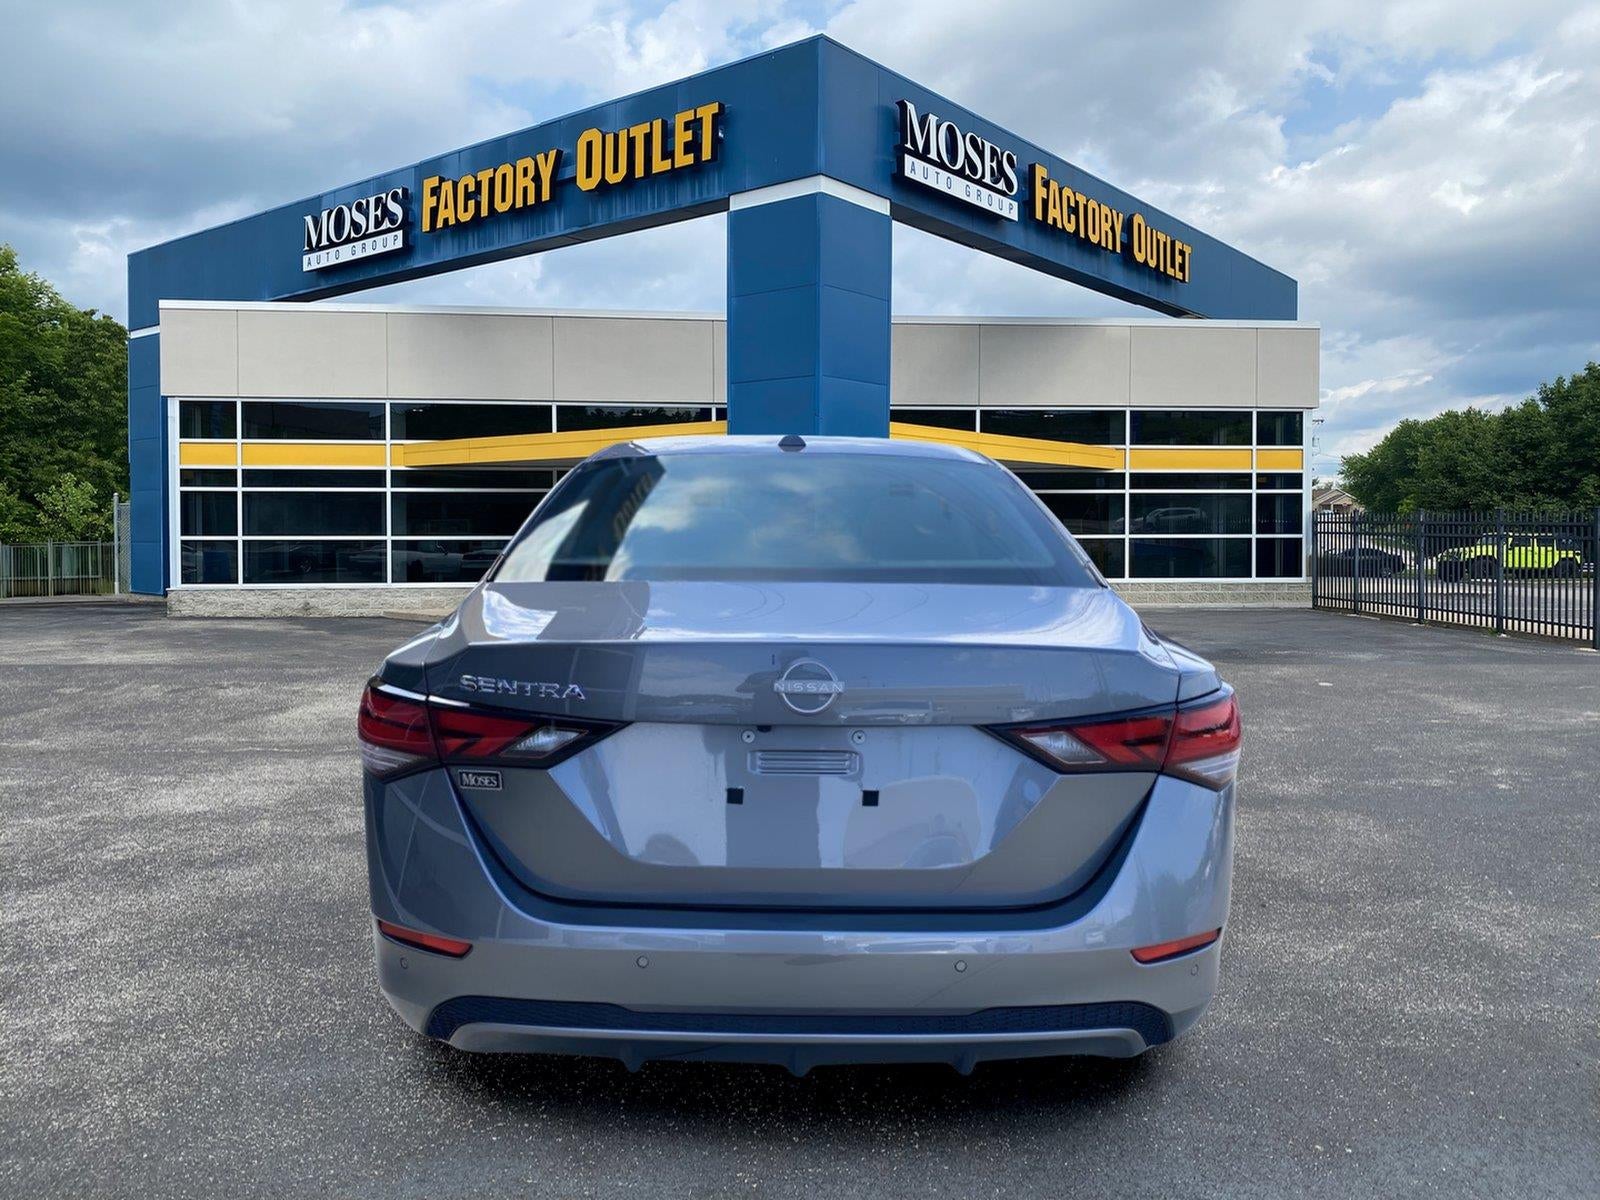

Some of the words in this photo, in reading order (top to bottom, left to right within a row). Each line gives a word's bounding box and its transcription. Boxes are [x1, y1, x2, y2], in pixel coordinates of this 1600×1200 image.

[422, 148, 558, 233] FACTORY
[577, 102, 720, 192] OUTLET
[902, 98, 1019, 196] MOSES
[908, 161, 953, 190] AUTO
[964, 184, 1015, 215] GROUP
[303, 187, 405, 251] MOSES
[1034, 163, 1124, 254] FACTORY
[1131, 212, 1193, 283] OUTLET
[307, 252, 345, 269] AUTO
[350, 234, 400, 256] GROUP
[460, 674, 586, 700] SENTRA
[774, 681, 844, 693] NISSAN
[462, 772, 498, 788] MOSES
